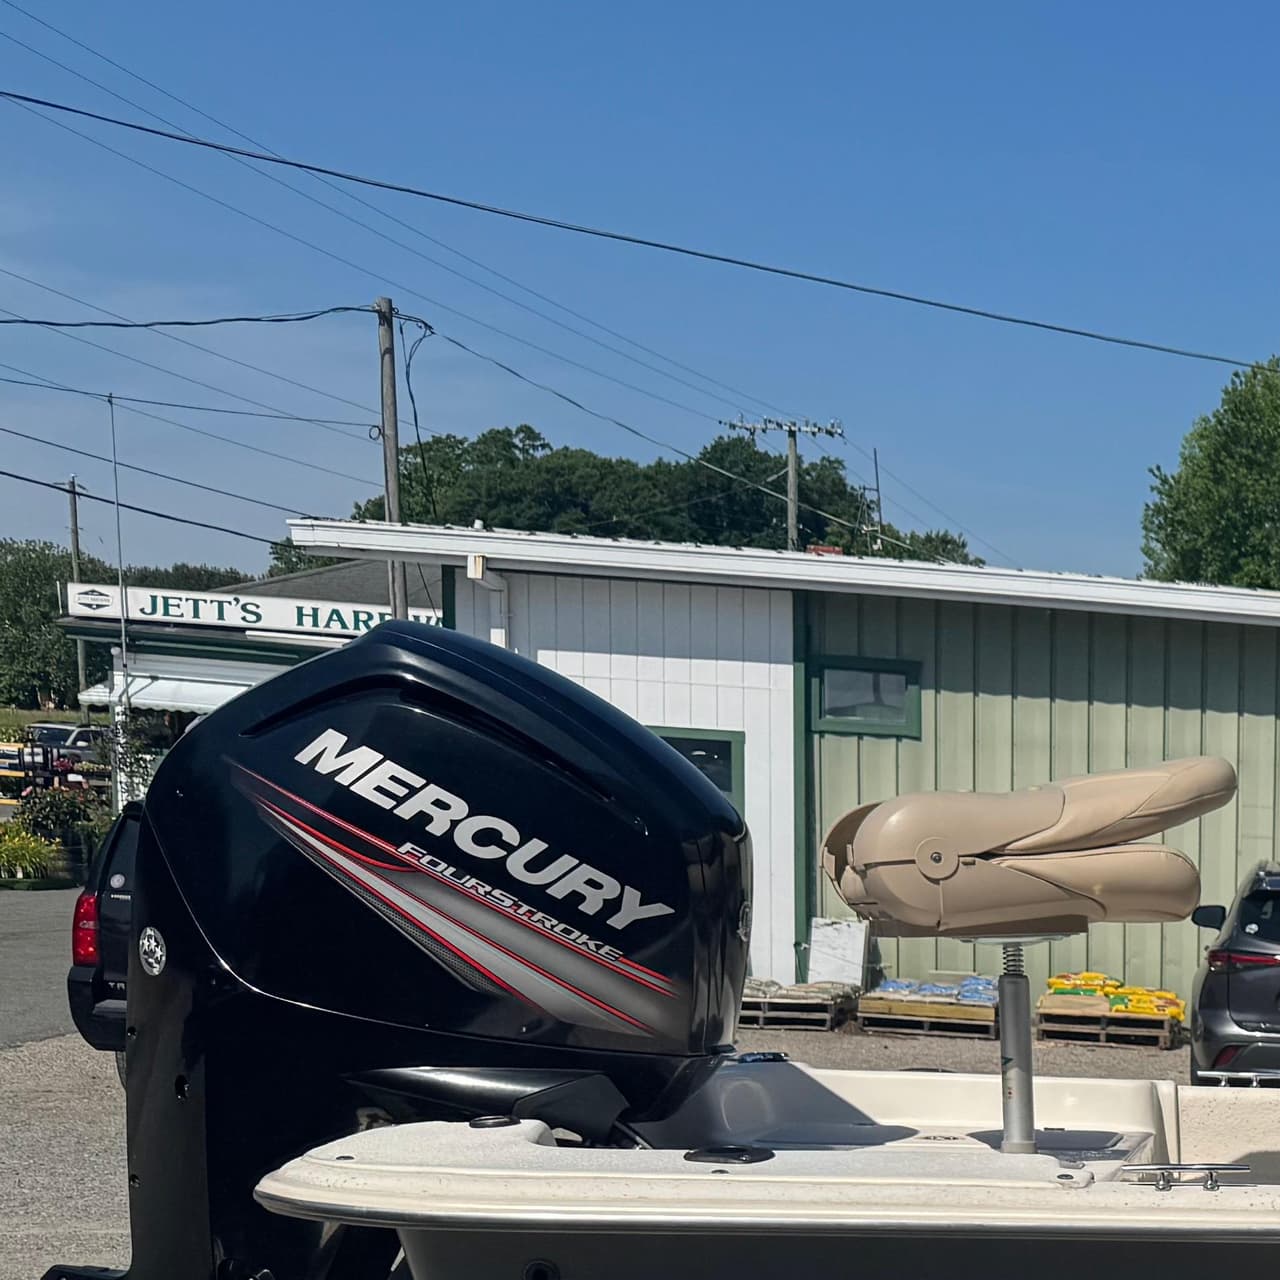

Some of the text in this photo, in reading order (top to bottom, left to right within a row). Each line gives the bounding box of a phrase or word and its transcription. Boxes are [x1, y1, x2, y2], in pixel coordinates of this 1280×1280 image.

[139, 595, 262, 624] JETT'S
[294, 728, 675, 930] MERCURY
[397, 841, 623, 961] FOURSTROKE
